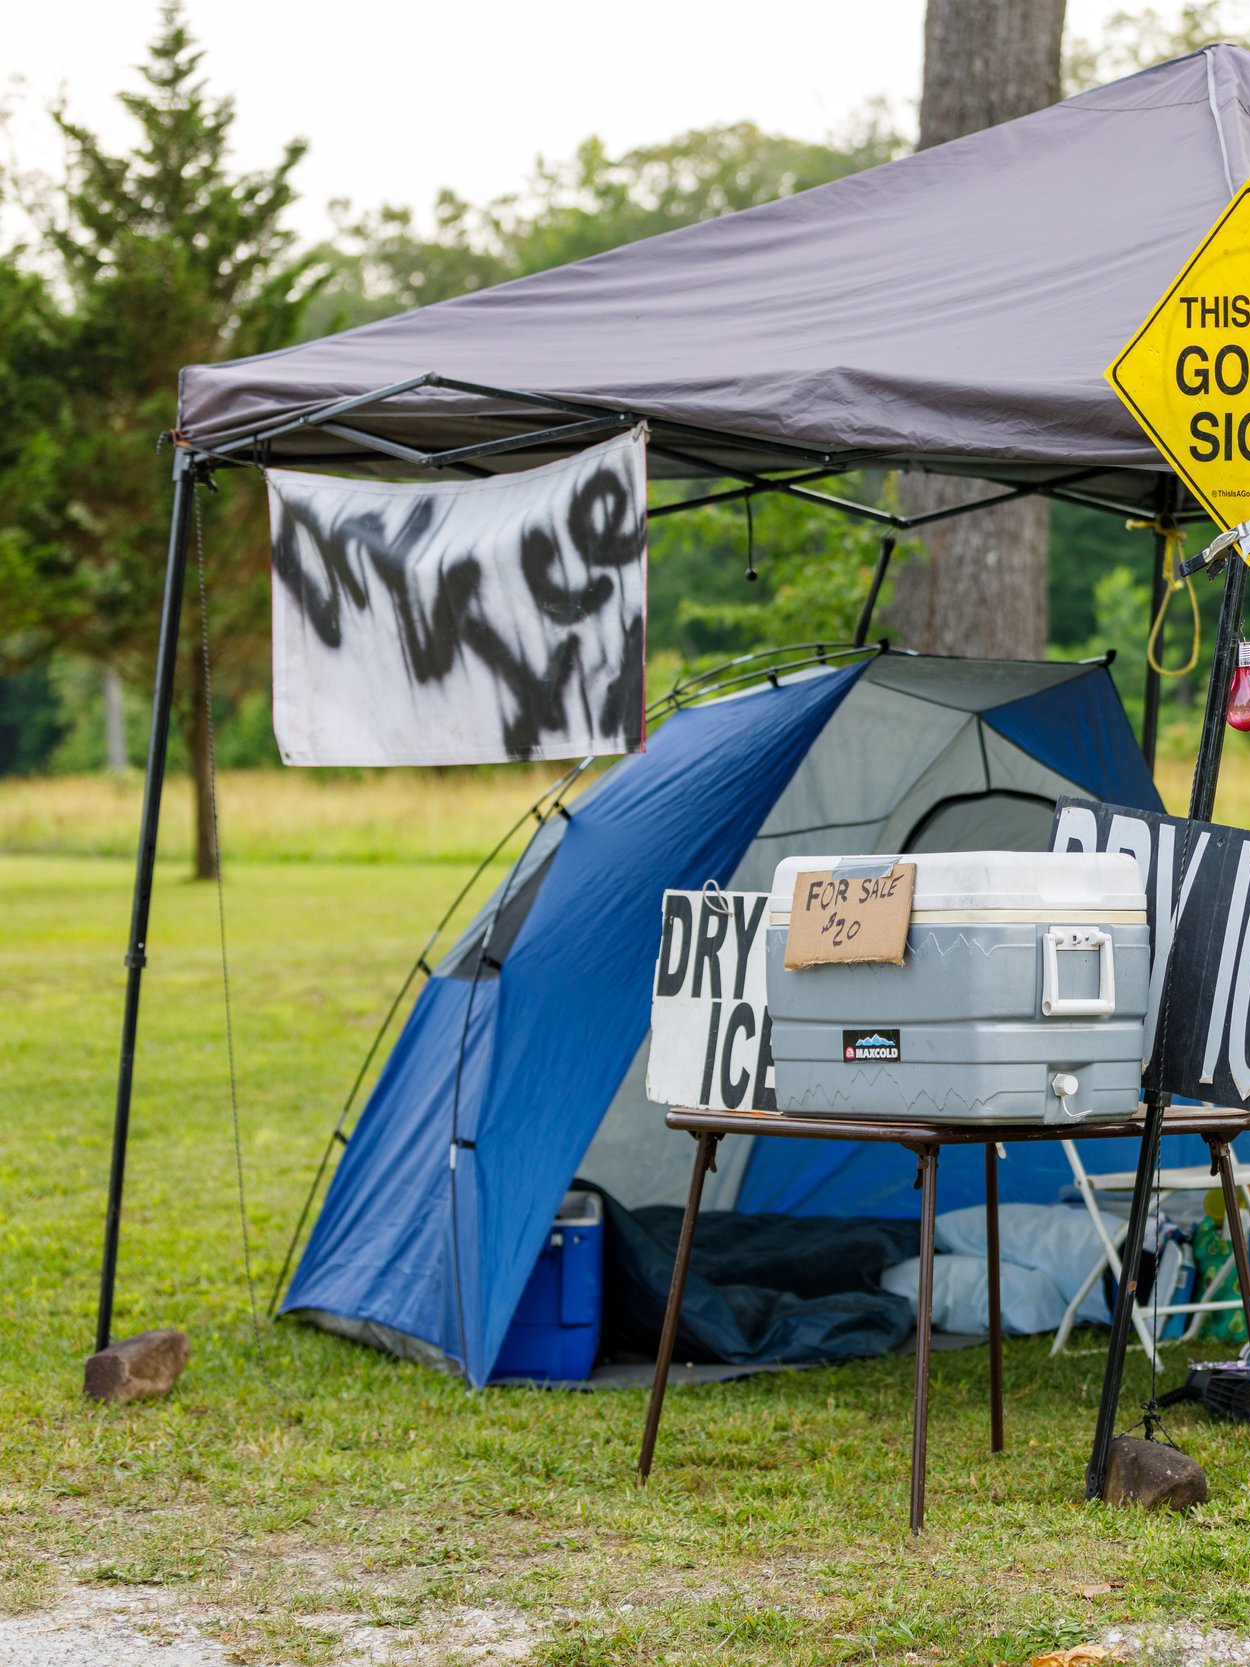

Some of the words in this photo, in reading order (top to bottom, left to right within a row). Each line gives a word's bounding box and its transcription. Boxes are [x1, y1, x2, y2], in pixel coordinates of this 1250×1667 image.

[1180, 295, 1250, 328] THIS
[806, 878, 850, 912] FOR
[858, 874, 905, 904] SALE
[656, 894, 769, 1000] DRY
[821, 911, 861, 948] $20
[855, 1047, 899, 1059] MAXCOLD
